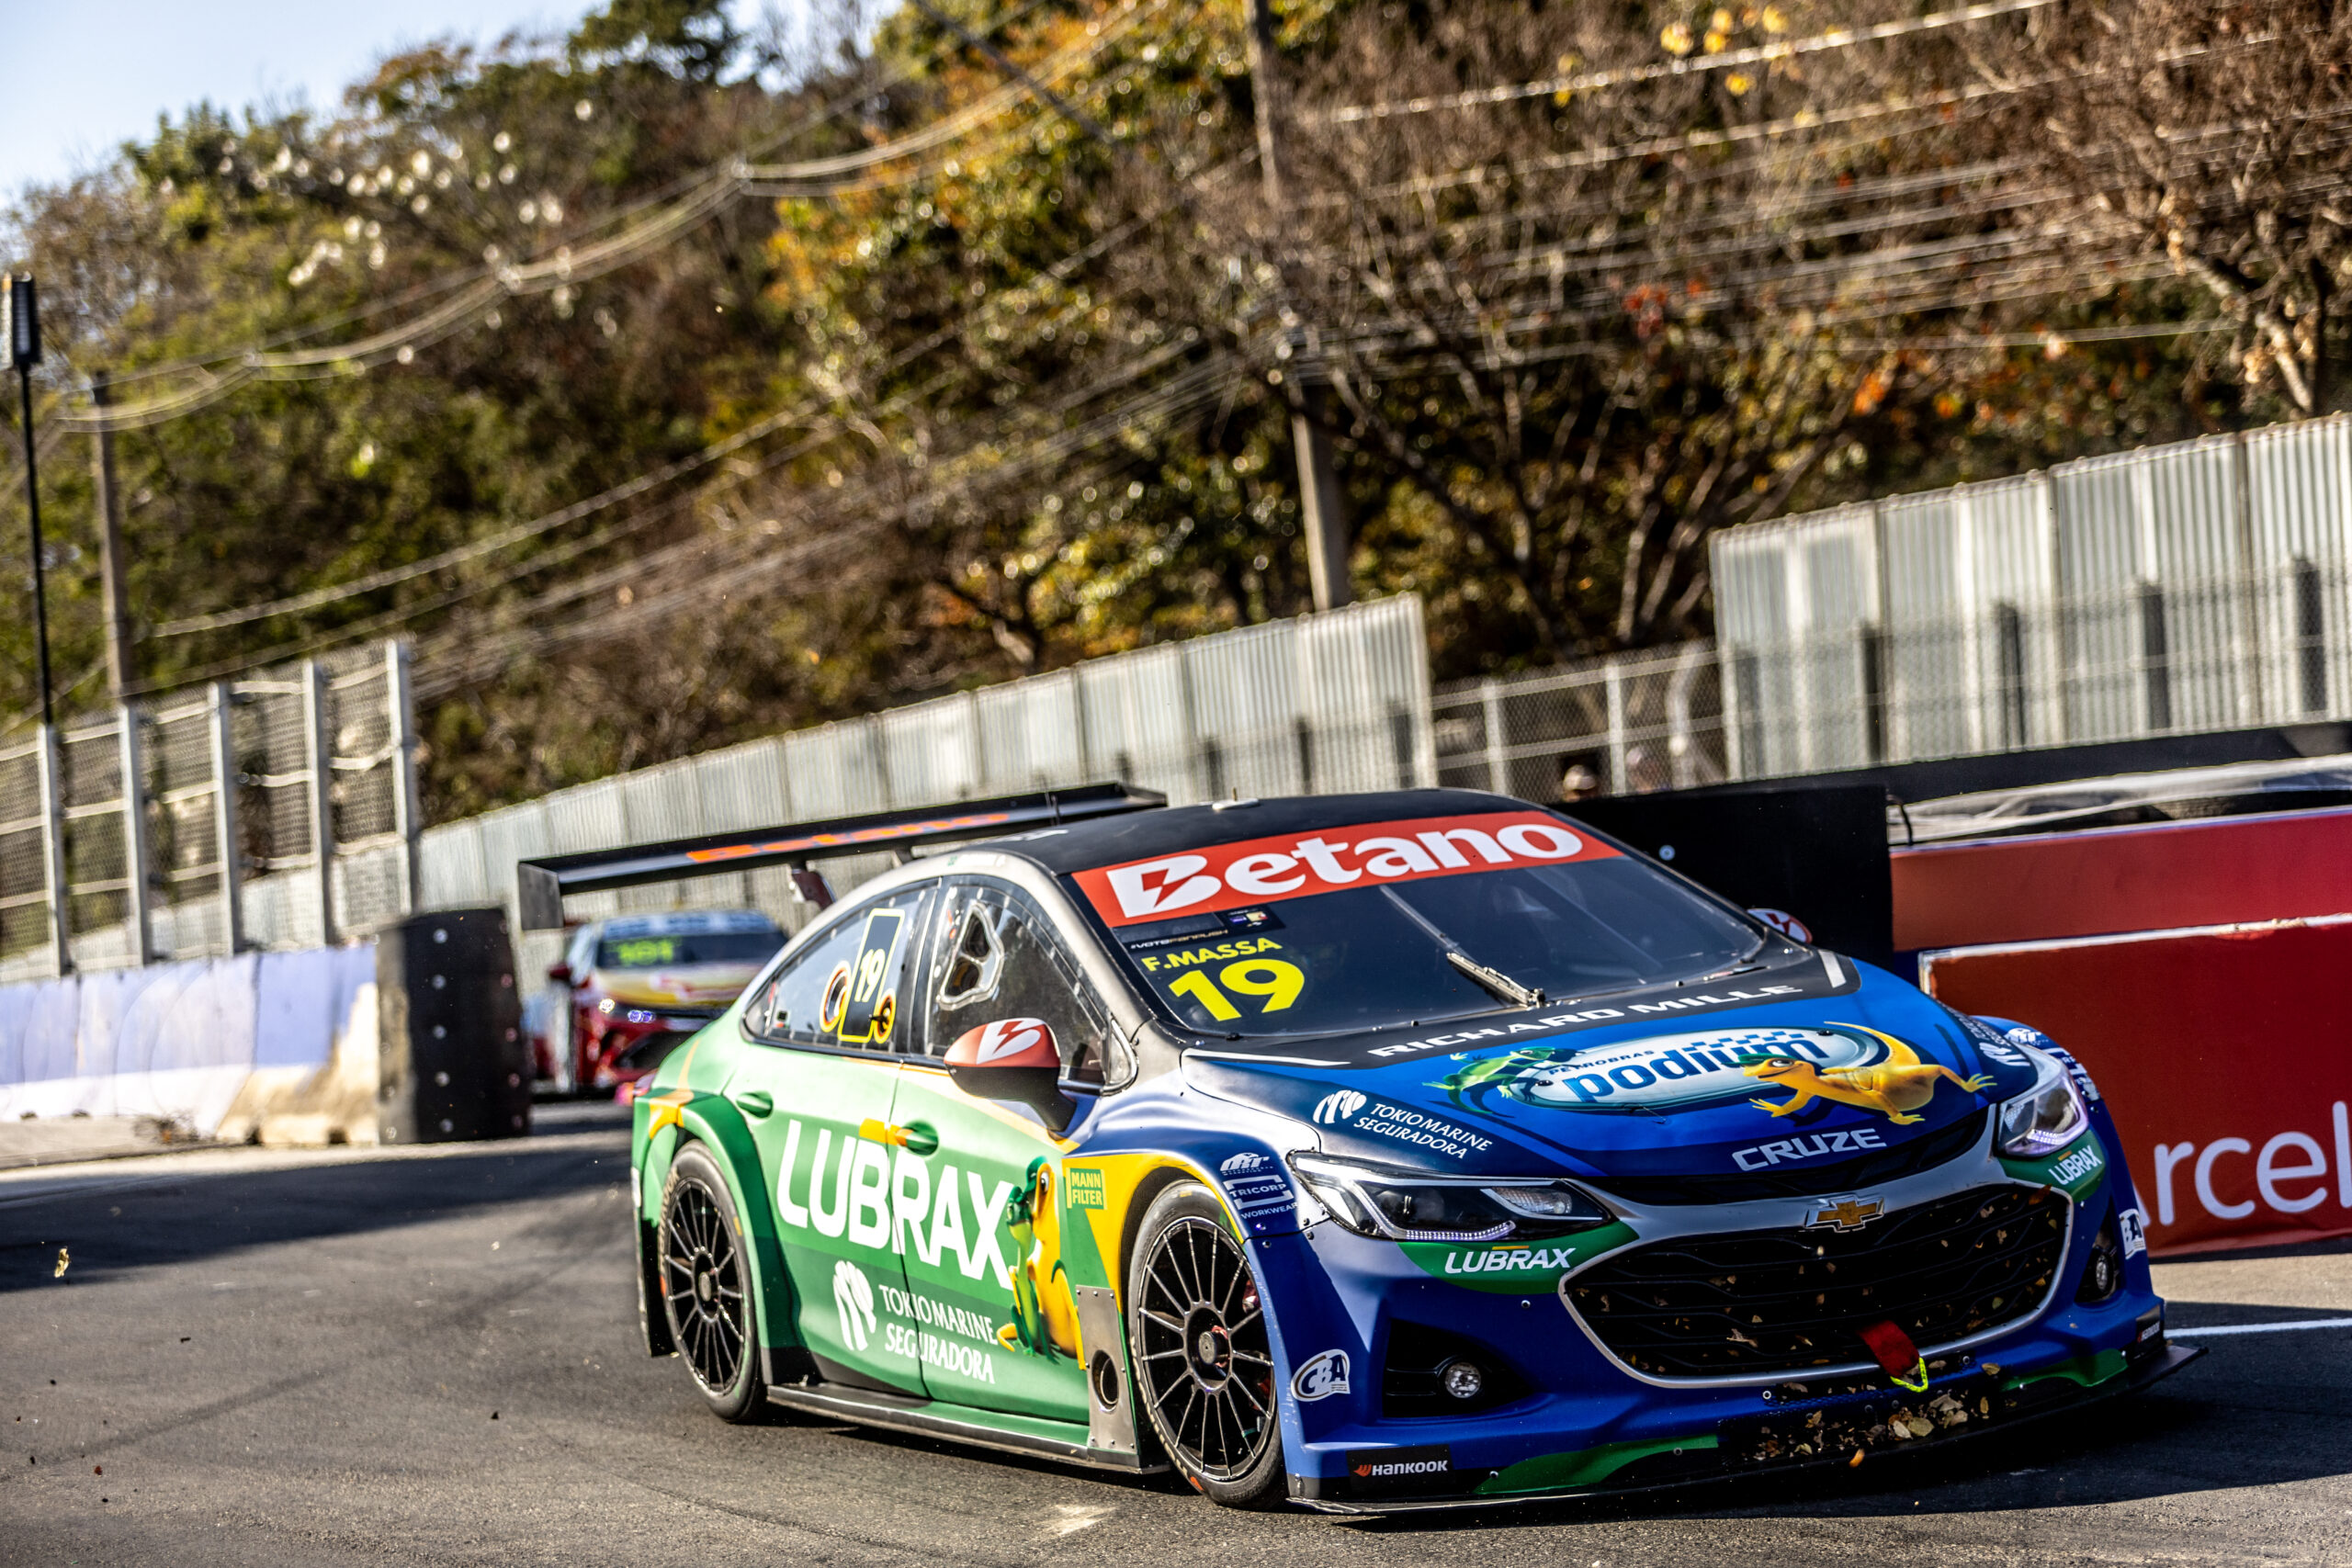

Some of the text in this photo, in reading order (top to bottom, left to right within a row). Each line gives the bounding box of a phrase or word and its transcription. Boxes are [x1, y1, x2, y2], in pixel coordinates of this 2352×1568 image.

[1106, 824, 1583, 918] Betano
[1141, 937, 1283, 971] F.MASSA
[854, 948, 886, 1002] 19
[1169, 958, 1305, 1021] 19
[1367, 984, 1804, 1057] RICHARD MILLE
[1549, 1050, 1655, 1075] PETROBRAS
[1562, 1039, 1830, 1102] podium
[1353, 1117, 1468, 1159] SEGURADORA
[1732, 1128, 1887, 1171] CRUZE
[1071, 1171, 1102, 1188] MANN
[2048, 1145, 2102, 1185] LUBRAX
[776, 1119, 1012, 1292] LUBRAX
[1072, 1189, 1103, 1205] FILTER
[1229, 1183, 1286, 1198] TRICORP
[1241, 1201, 1298, 1220] WORKWEAR
[1444, 1247, 1577, 1274] LUBRAX
[885, 1322, 995, 1384] SEGURADORA
[1301, 1354, 1347, 1394] CBA
